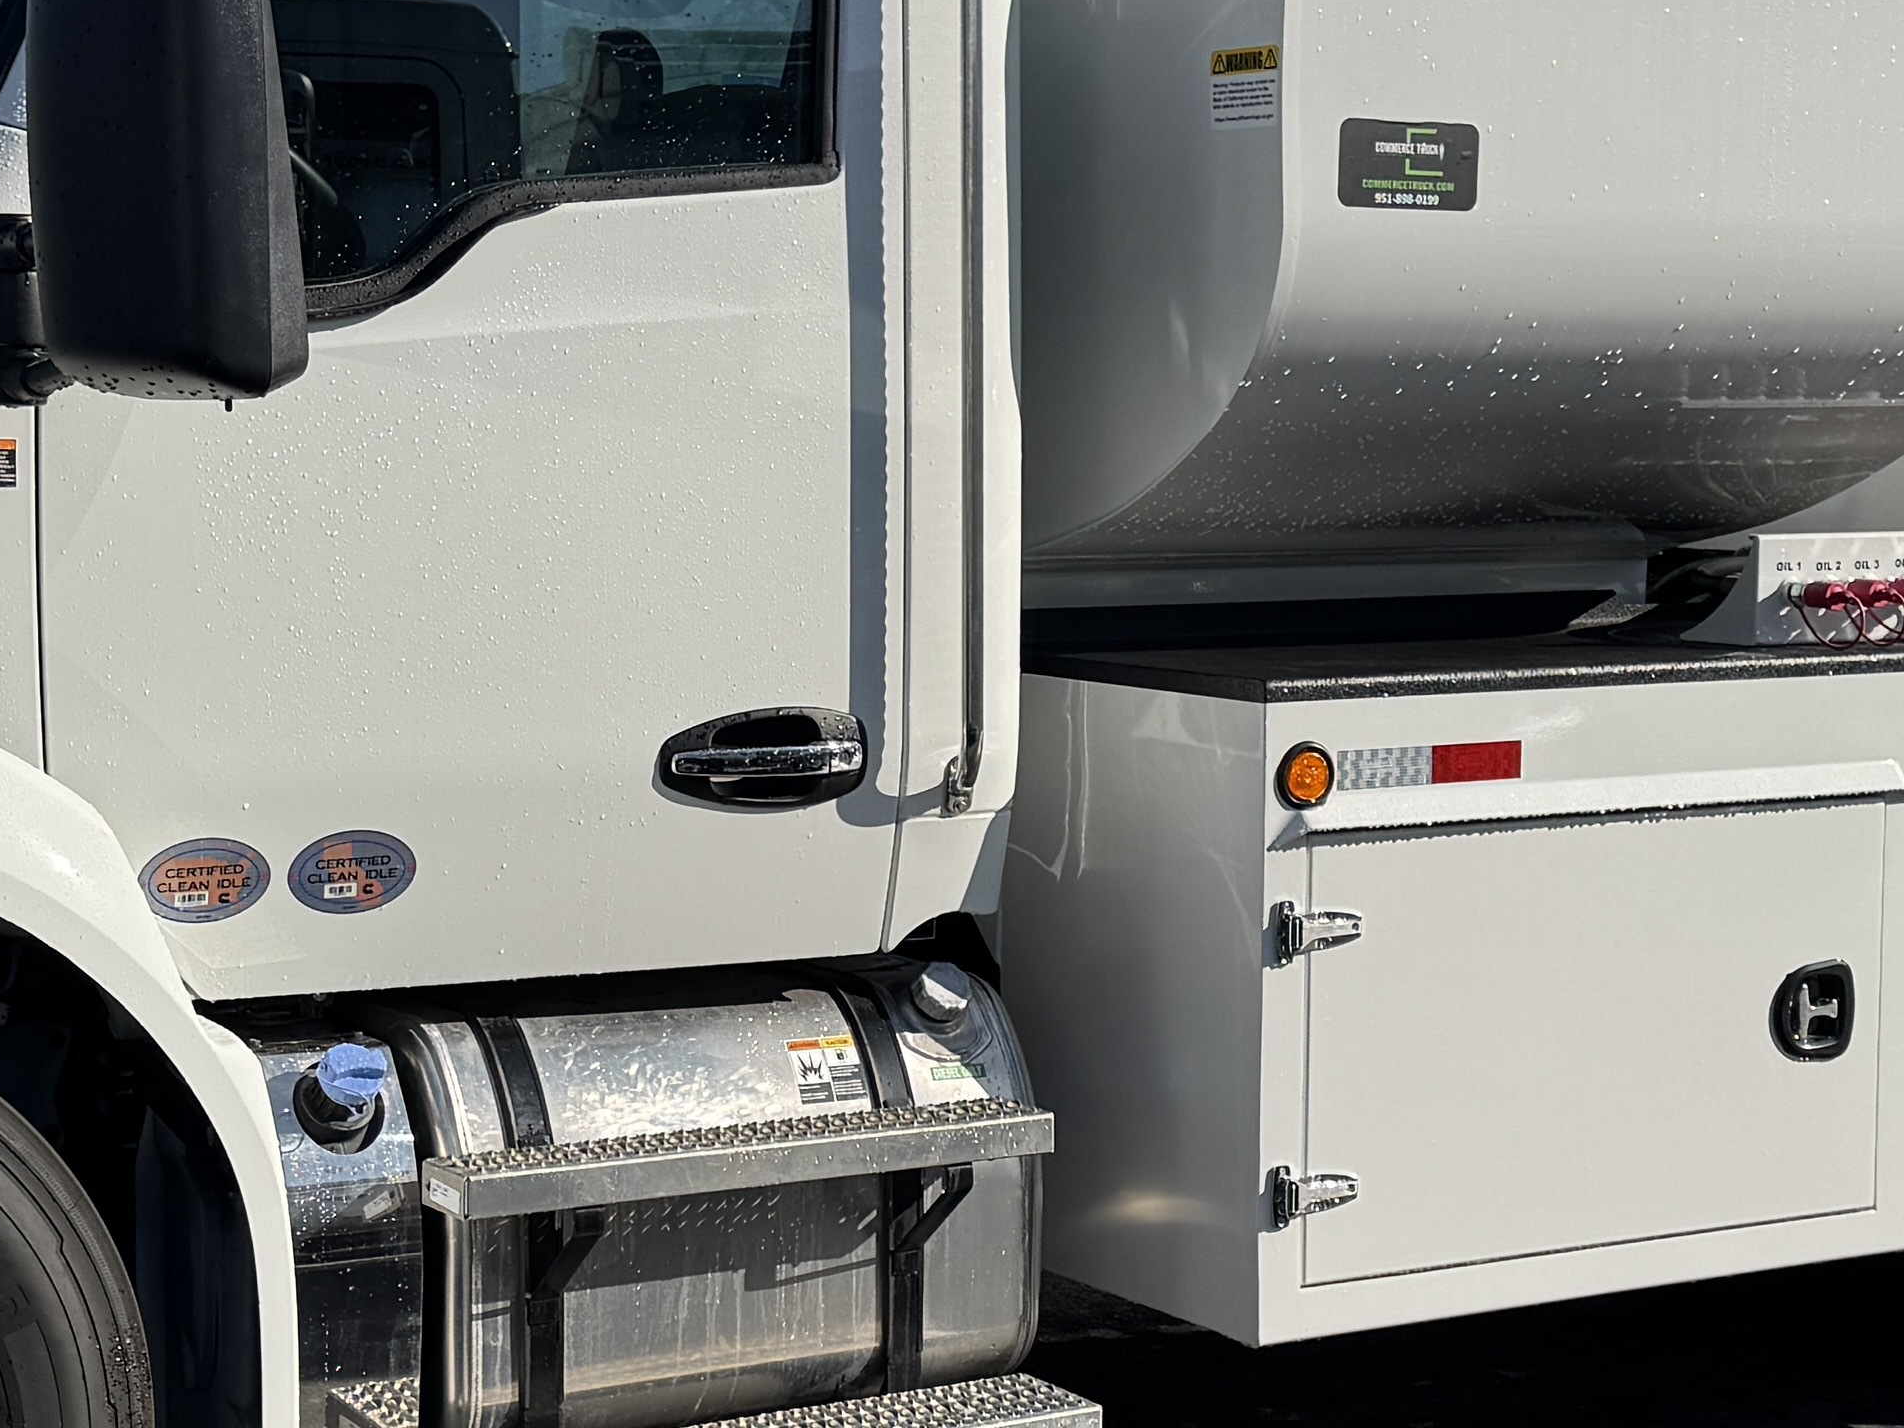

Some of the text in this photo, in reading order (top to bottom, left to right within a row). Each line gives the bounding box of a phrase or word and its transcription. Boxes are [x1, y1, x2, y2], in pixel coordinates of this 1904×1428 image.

[1226, 51, 1263, 72] WARNING
[1375, 141, 1439, 155] COMMERCE TRUCK
[1776, 561, 1794, 571] OIL
[1816, 561, 1842, 571] OIL 2
[1854, 559, 1880, 570] OIL 3
[315, 855, 392, 870] CERTIFIED
[165, 864, 244, 879] CERTIFIED
[307, 867, 399, 884] CLEAN IDLE
[156, 876, 251, 893] CLEAN IDLE
